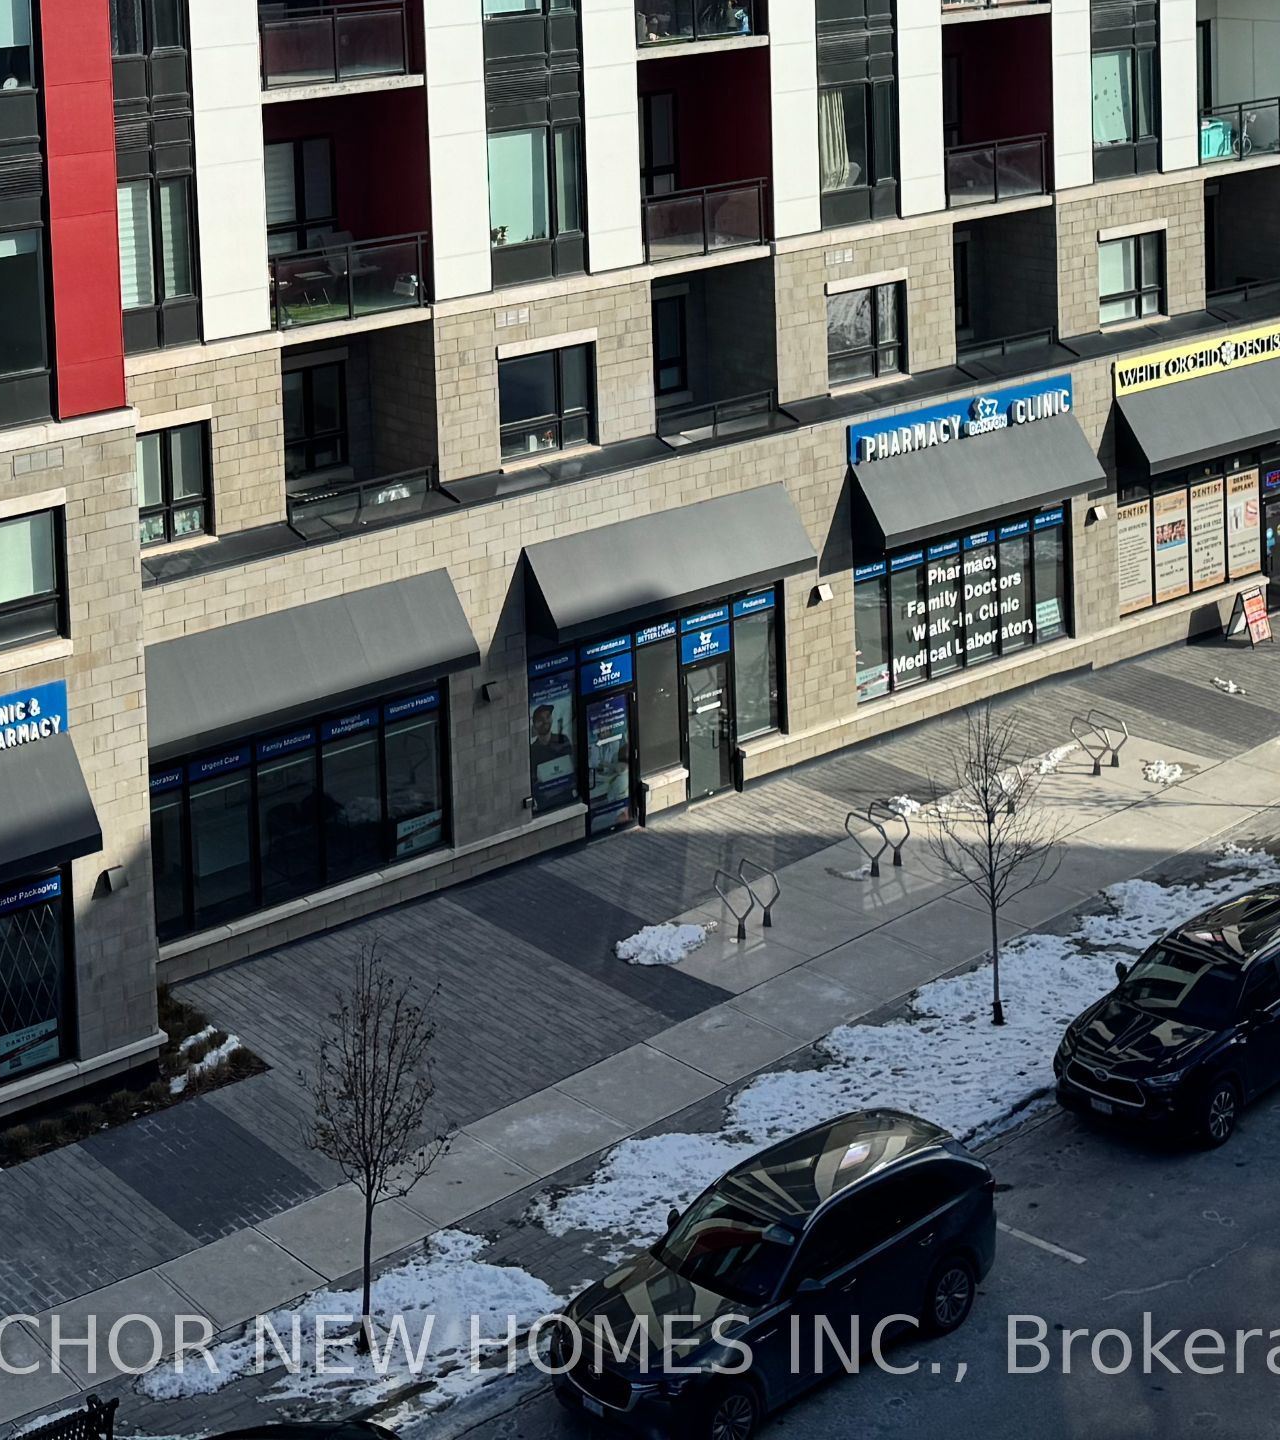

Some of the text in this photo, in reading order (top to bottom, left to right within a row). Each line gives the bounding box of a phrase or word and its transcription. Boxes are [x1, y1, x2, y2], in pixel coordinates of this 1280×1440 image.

[1167, 349, 1220, 376] ORCHID
[1013, 389, 1070, 424] CLINIC
[967, 414, 1008, 436] DANTON
[860, 414, 962, 462] PHARMACY
[1192, 482, 1221, 498] DENTIST
[1232, 482, 1253, 492] IMPLANT
[1117, 504, 1148, 520] DENTIST
[873, 563, 883, 571] Care
[928, 555, 997, 586] Pharmacy
[907, 572, 1021, 618] Family Doctors
[912, 612, 973, 642] Walk-in
[979, 596, 1020, 621] Clinic
[693, 641, 719, 655] DANTON
[893, 618, 1033, 675] Medical Laboratory
[593, 671, 621, 685] DANTON
[28, 697, 41, 717] &
[390, 695, 435, 714] Women's Health
[331, 718, 370, 735] Management
[262, 733, 311, 753] Family Medicine
[201, 754, 240, 773] Urgent Care
[18, 881, 58, 903] Packaging
